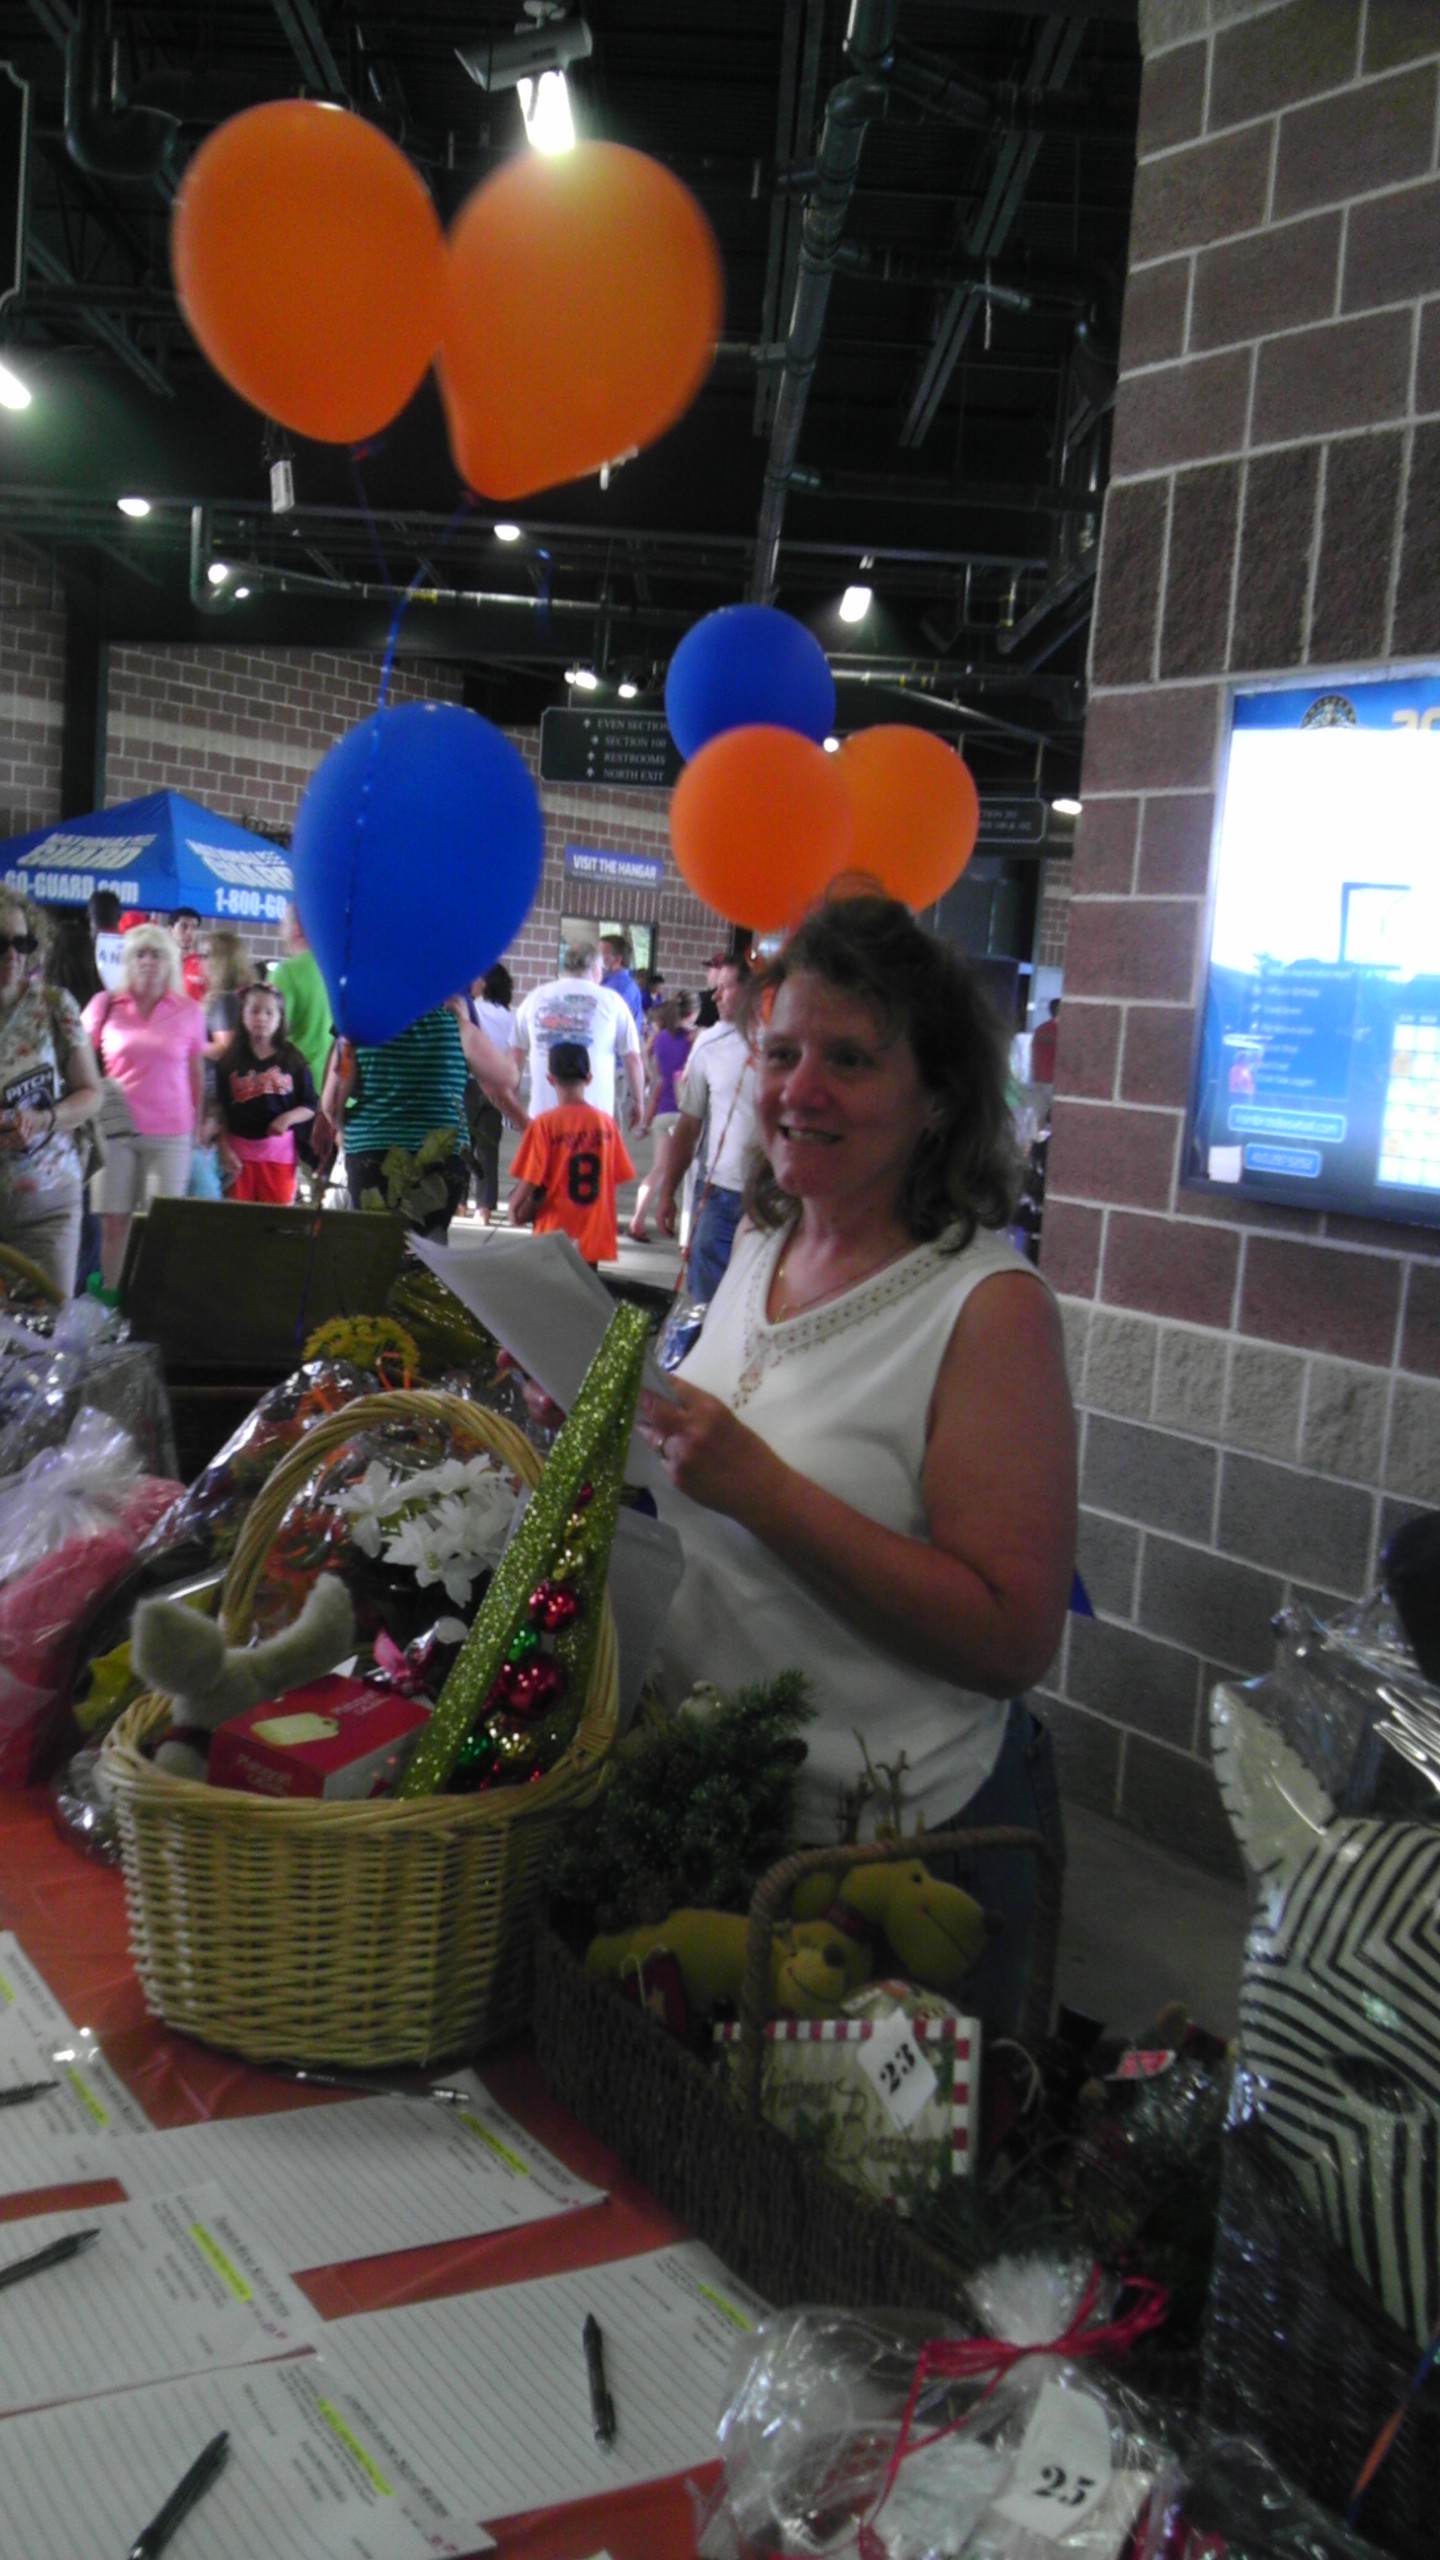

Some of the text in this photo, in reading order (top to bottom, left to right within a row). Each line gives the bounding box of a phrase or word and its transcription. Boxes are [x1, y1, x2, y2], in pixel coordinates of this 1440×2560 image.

[597, 718, 625, 730] EVEN
[604, 736, 648, 748] SECTION
[603, 752, 666, 765] RESTROOMS
[603, 767, 664, 782] NORTH EXIT
[573, 854, 597, 871] VISIT
[599, 857, 617, 874] THE
[618, 861, 657, 880] HANGAR
[569, 1153, 601, 1206] 8
[879, 2042, 916, 2096] 23
[1033, 2464, 1096, 2508] 25
